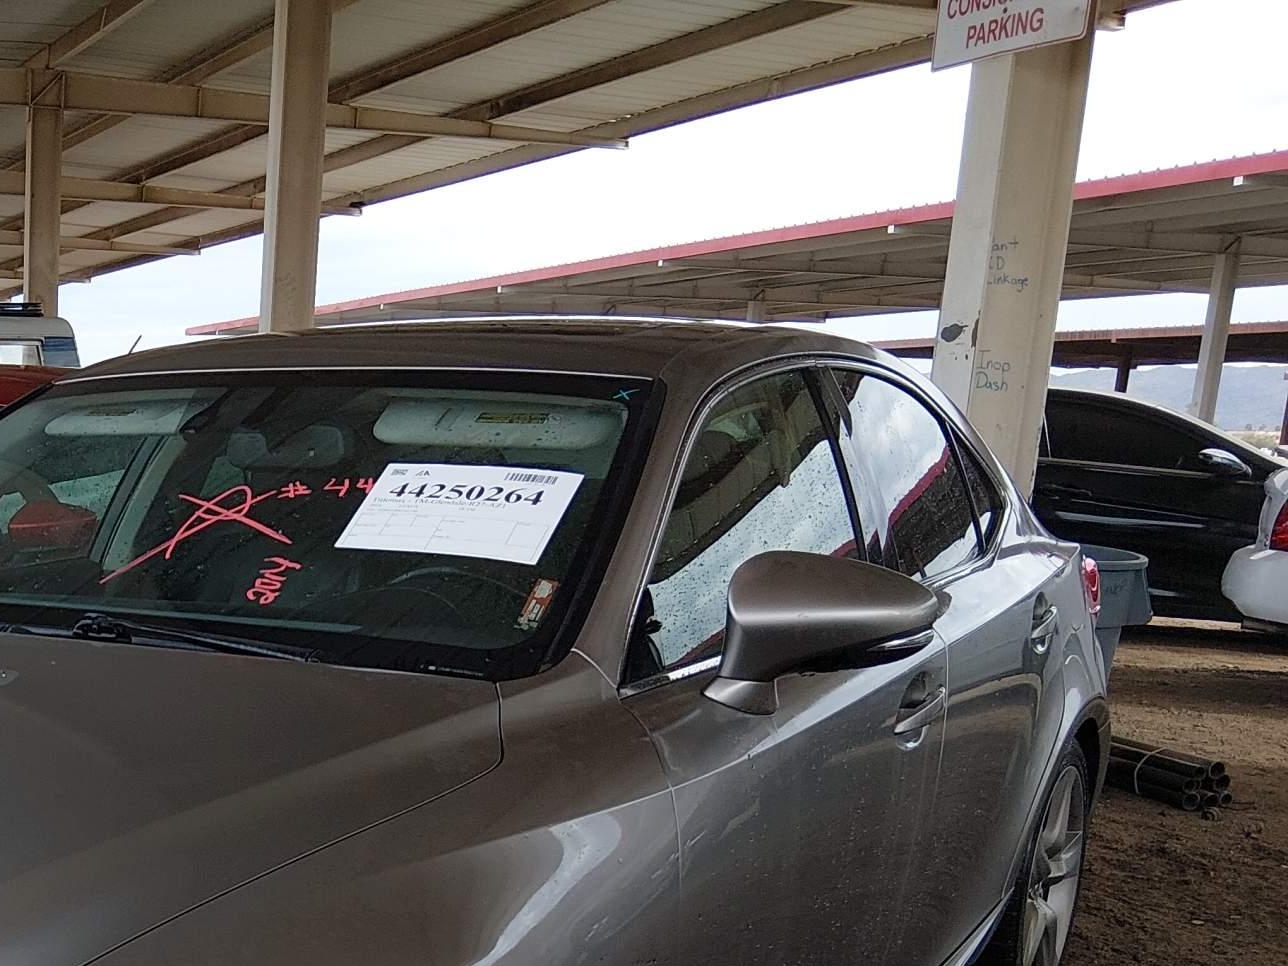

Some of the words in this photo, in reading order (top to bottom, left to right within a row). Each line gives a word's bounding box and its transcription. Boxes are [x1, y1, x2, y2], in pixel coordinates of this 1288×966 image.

[965, 7, 1045, 49] PARKING
[976, 350, 1011, 373] Inop
[975, 371, 1009, 392] Dash
[389, 482, 546, 506] 44250264
